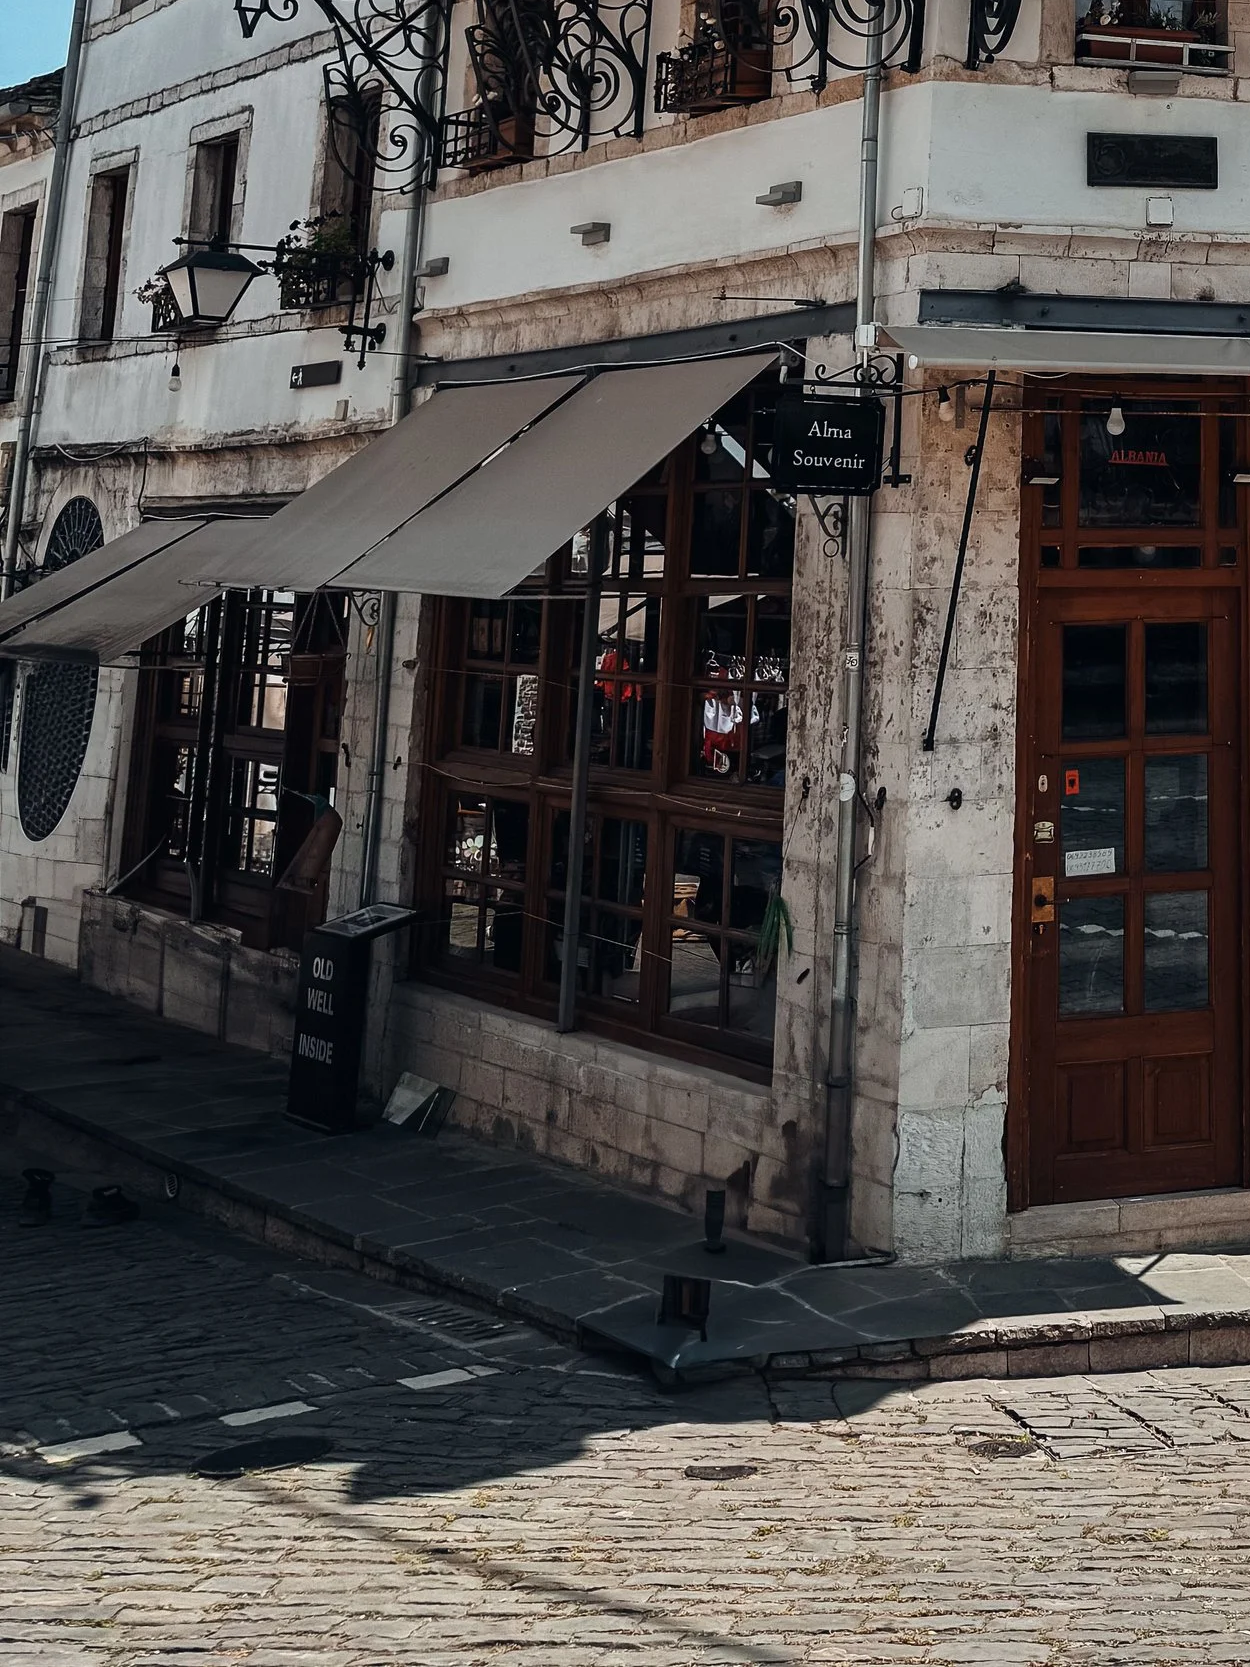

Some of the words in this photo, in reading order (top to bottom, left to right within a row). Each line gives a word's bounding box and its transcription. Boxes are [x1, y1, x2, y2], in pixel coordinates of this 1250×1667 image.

[808, 421, 852, 439] Alma
[793, 450, 866, 470] Souvenir
[1111, 449, 1167, 464] ALBANIA
[313, 956, 334, 982] OLD
[307, 987, 334, 1016] WELL
[298, 1032, 334, 1065] INSIDE
